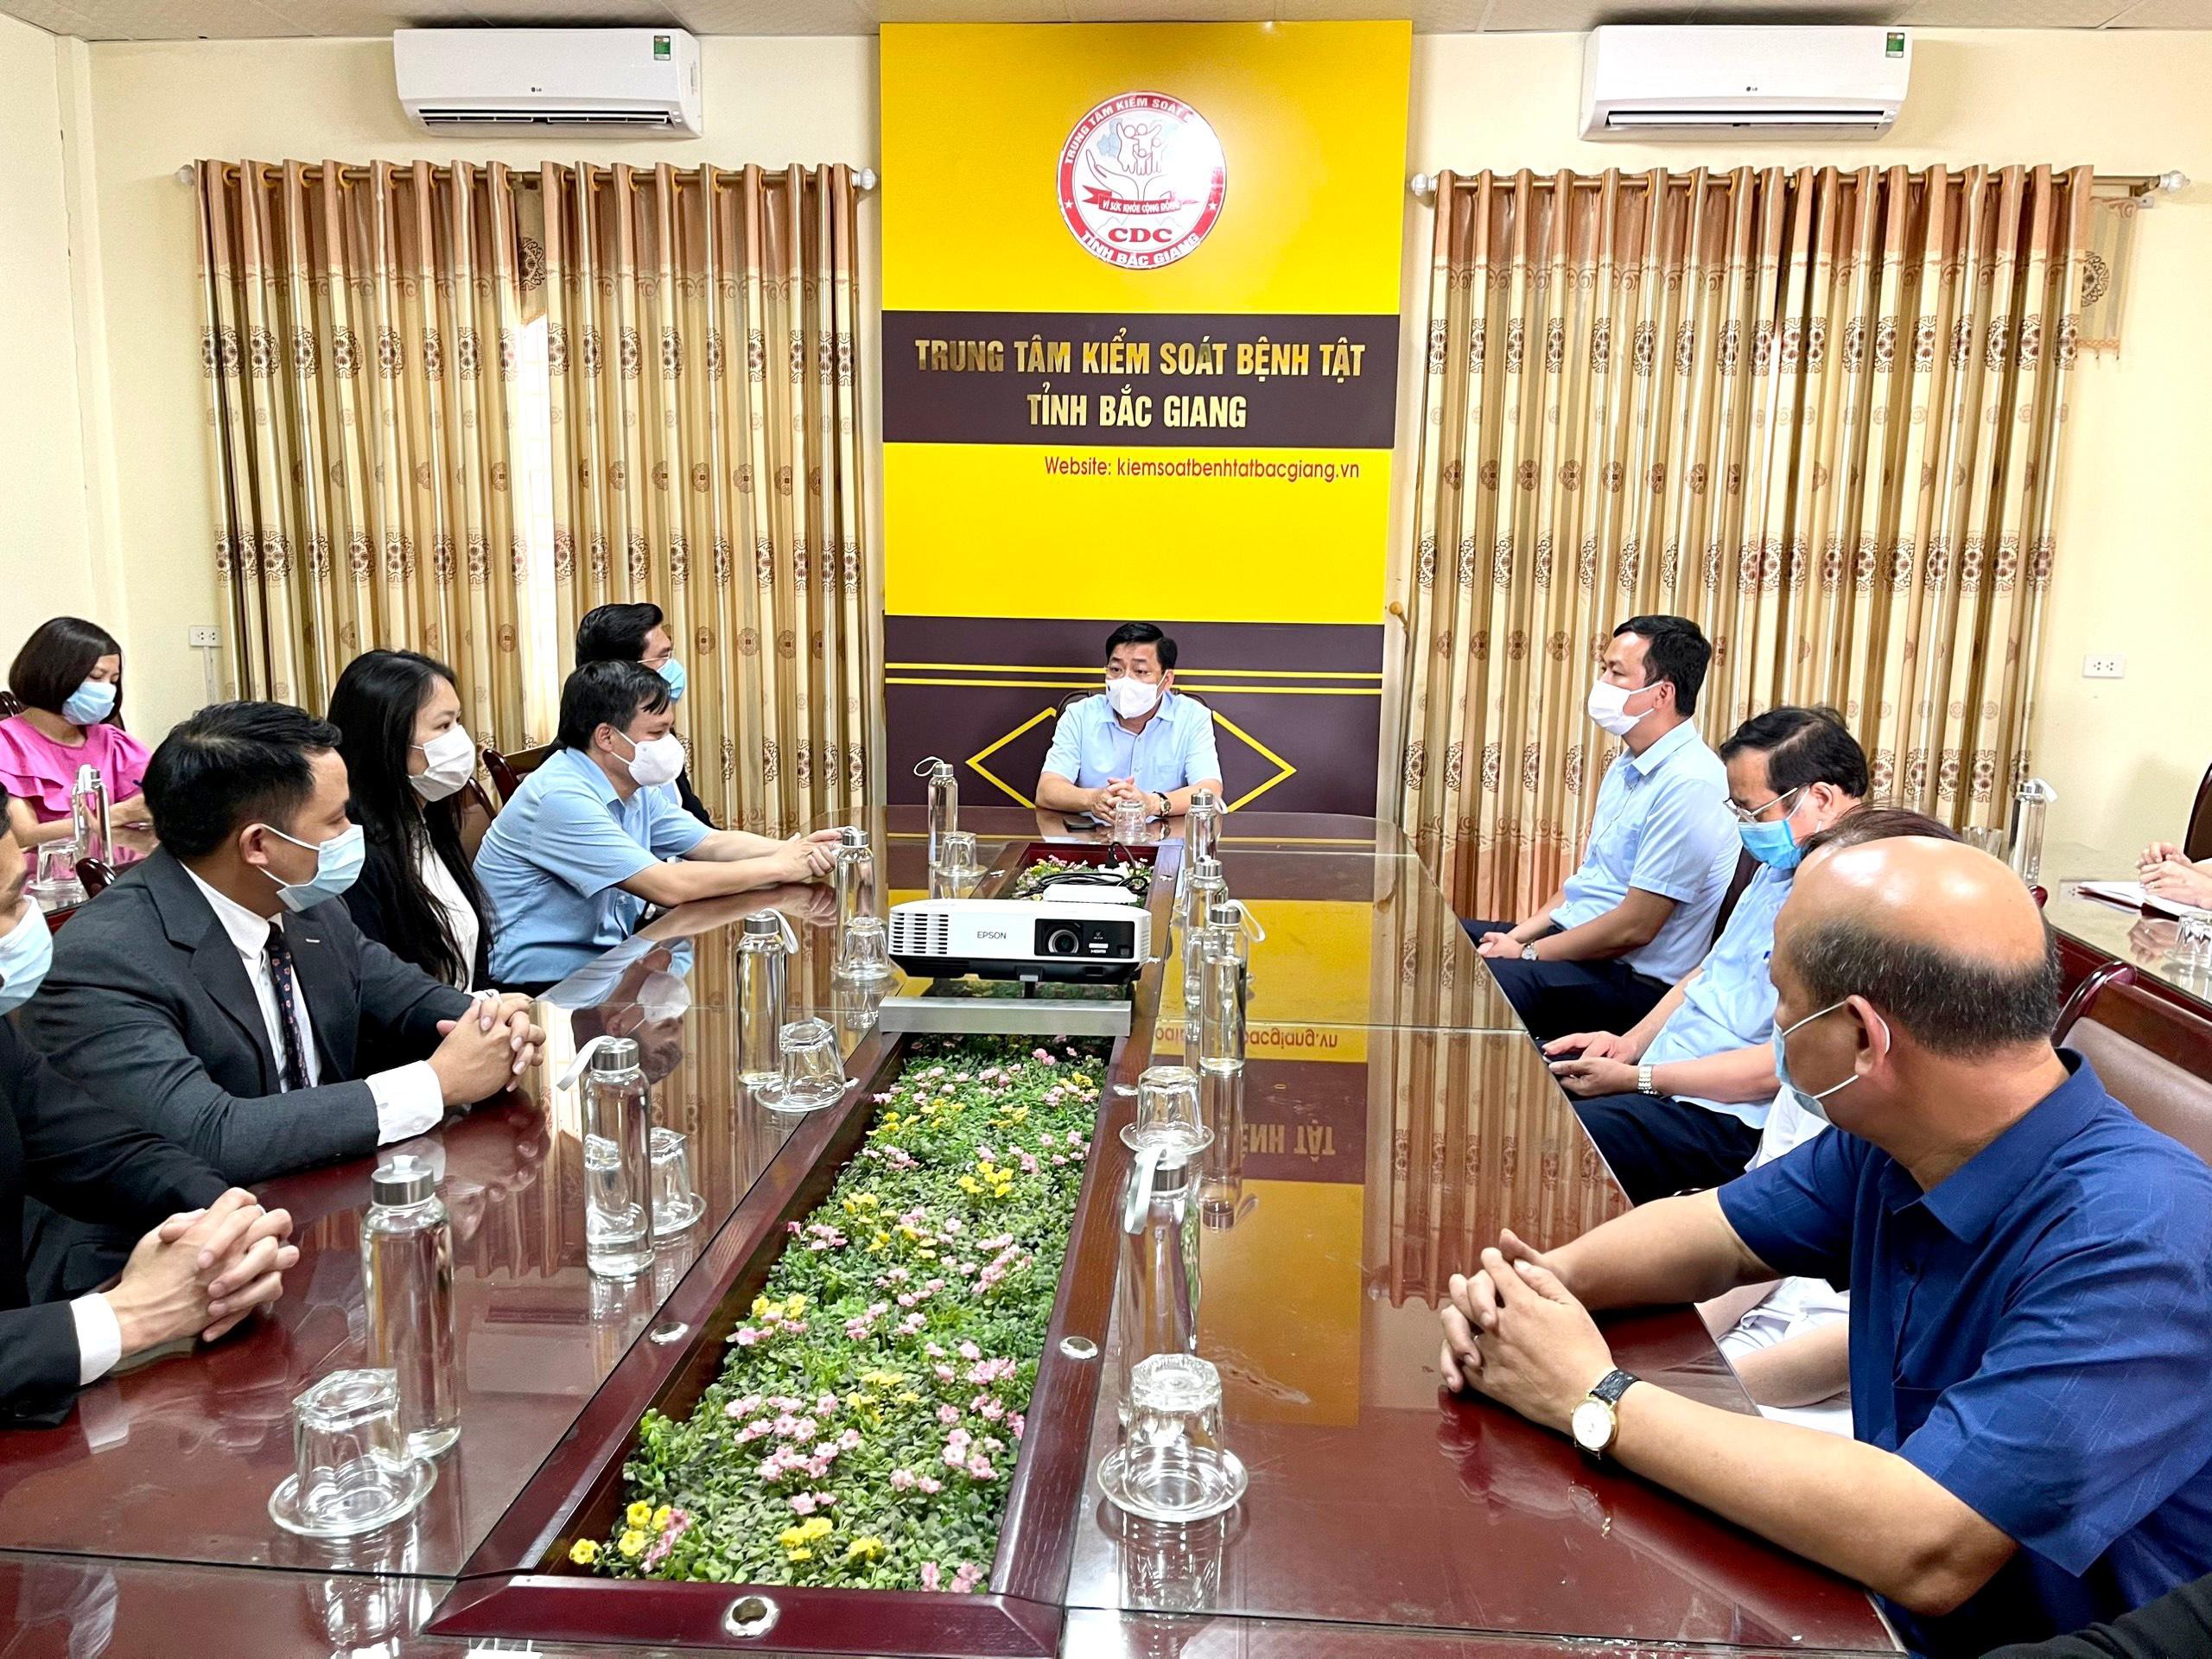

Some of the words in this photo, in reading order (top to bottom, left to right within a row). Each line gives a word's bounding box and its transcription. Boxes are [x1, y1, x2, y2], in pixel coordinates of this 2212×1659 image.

[1064, 125, 1090, 164] TRUNG
[1108, 227, 1173, 243] CDC
[1154, 232, 1201, 264] GIANG
[915, 340, 1004, 372] TRUNG
[1014, 334, 1071, 373] TÂM
[1082, 327, 1150, 374] KIỂM
[1160, 335, 1228, 375] SOÁT
[1236, 336, 1309, 382] BỆNH
[1319, 337, 1365, 383] TẬT
[1027, 381, 1087, 426] TỈNH
[1099, 384, 1153, 427] BẮC
[1164, 395, 1247, 428] GIANG
[1045, 456, 1112, 475] Website:
[1117, 458, 1360, 482] kiemsoatbenhtatbacgiang.vn
[976, 931, 1007, 940] EPSON
